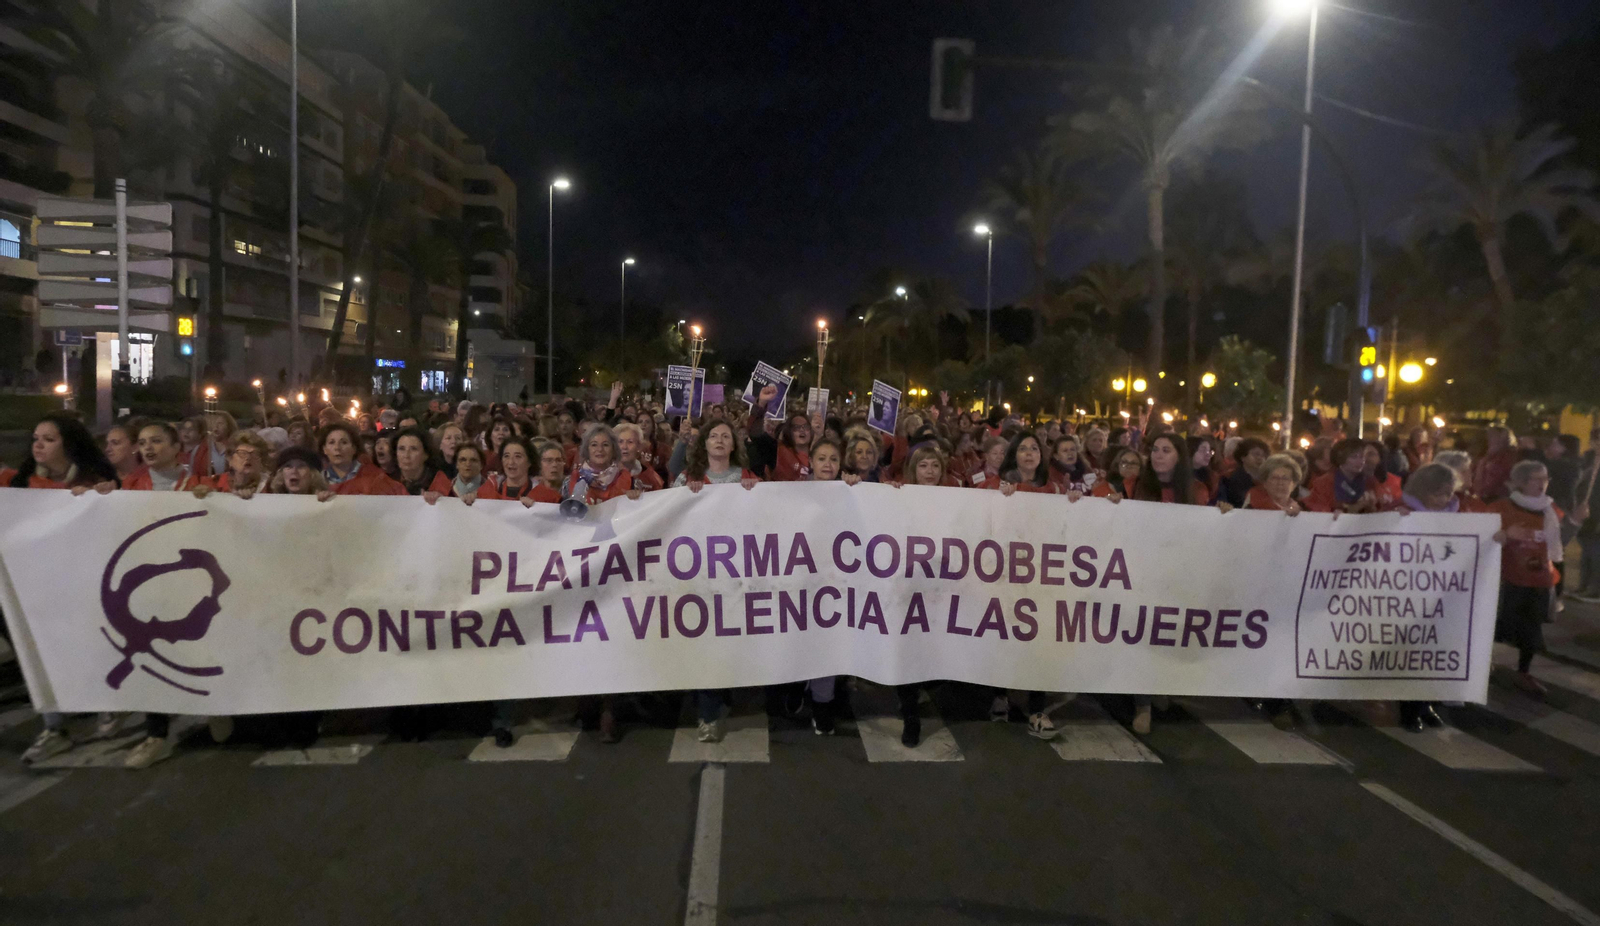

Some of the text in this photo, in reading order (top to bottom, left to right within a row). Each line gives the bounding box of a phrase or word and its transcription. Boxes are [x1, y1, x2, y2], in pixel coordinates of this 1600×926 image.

[669, 382, 683, 390] 25N
[753, 375, 767, 386] 25N
[471, 531, 1131, 595] PLATAFORMA CORDOBESA
[1346, 538, 1435, 564] 25N DÍA
[1310, 568, 1469, 592] INTERNACIONAL
[1327, 594, 1444, 618] CONTRA LA
[290, 586, 1270, 655] CONTRA LA VIOLENCIA A LAS MUJERES
[1331, 621, 1438, 645] VIOLENCIA
[1305, 649, 1460, 671] A LAS MUJERES
